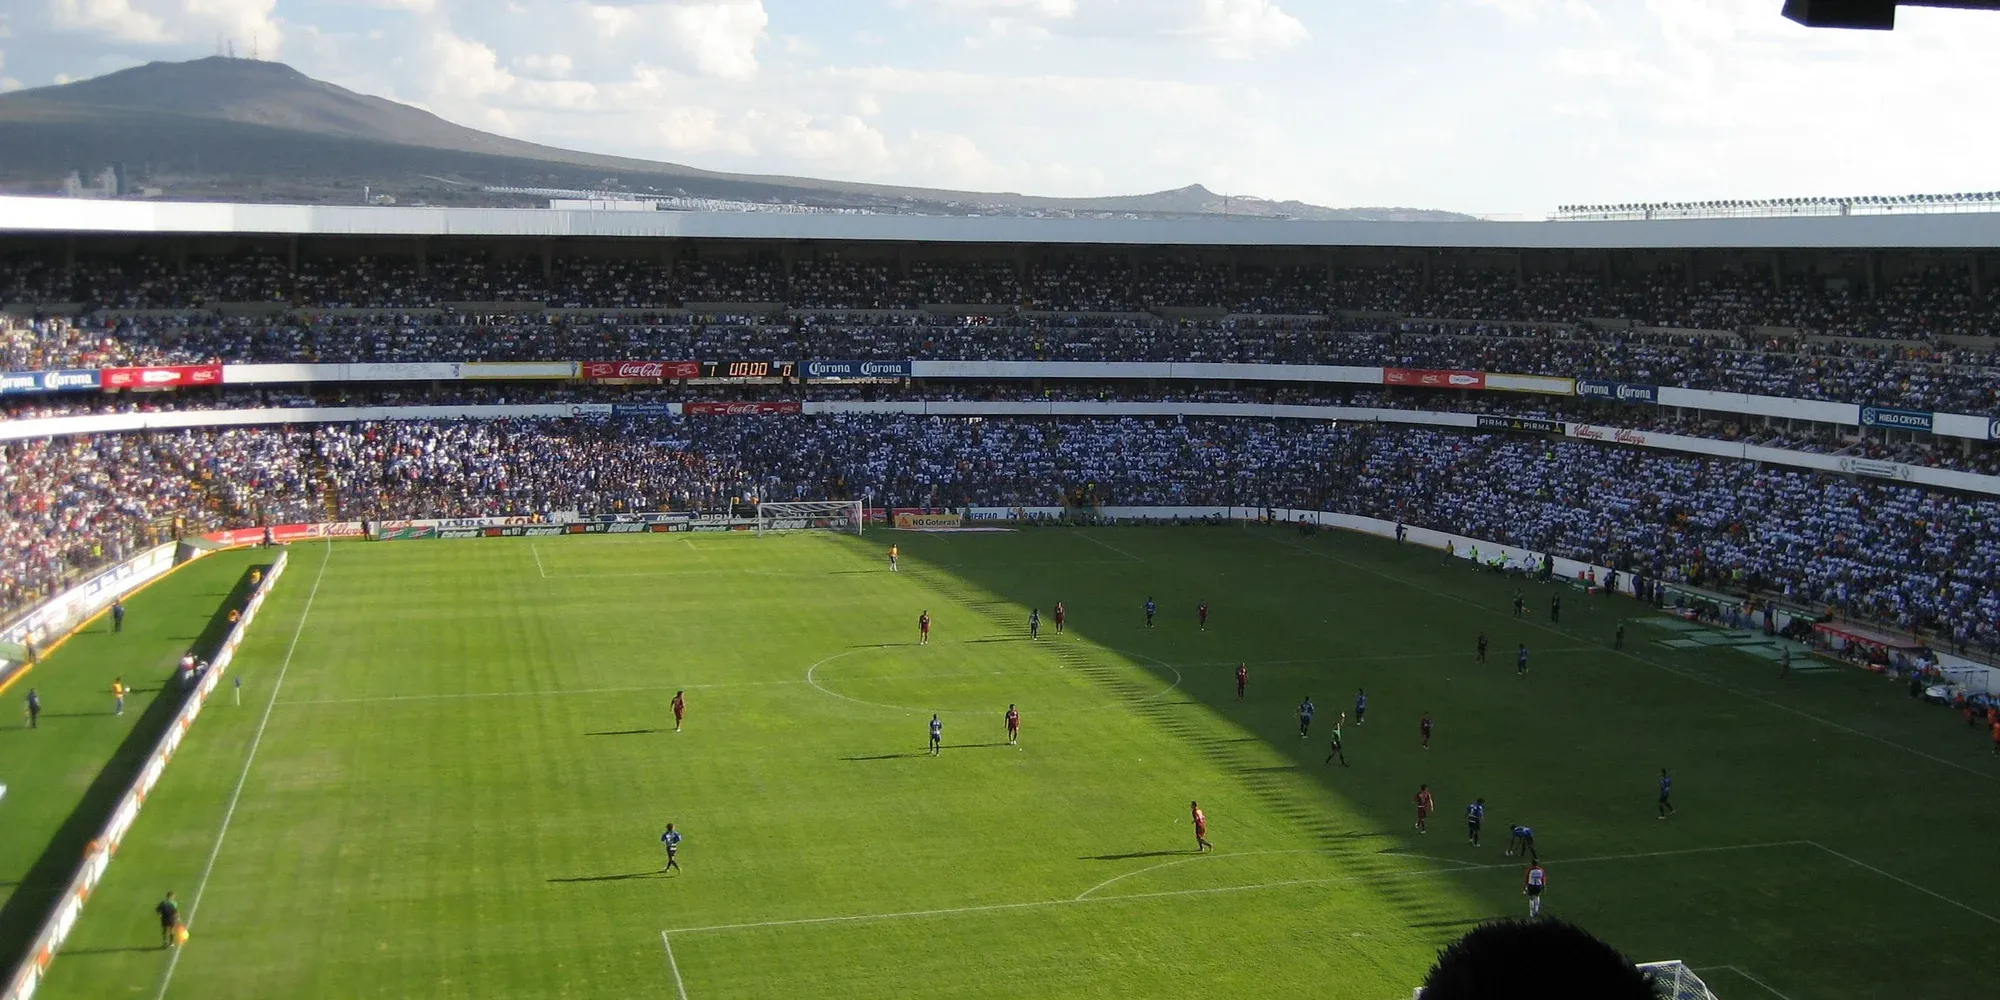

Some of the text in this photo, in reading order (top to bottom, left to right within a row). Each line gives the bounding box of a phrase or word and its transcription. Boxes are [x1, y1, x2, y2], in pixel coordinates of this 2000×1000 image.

[808, 361, 851, 377] Corona
[860, 361, 902, 377] Corona
[44, 372, 92, 390] Corona
[1576, 381, 1609, 397] Corona
[1616, 384, 1651, 401] Corona
[1479, 418, 1509, 427] PIRMA
[1523, 422, 1550, 431] PIRMA
[1879, 414, 1930, 427] HIELO CRYSTAL
[912, 518, 925, 526] NO
